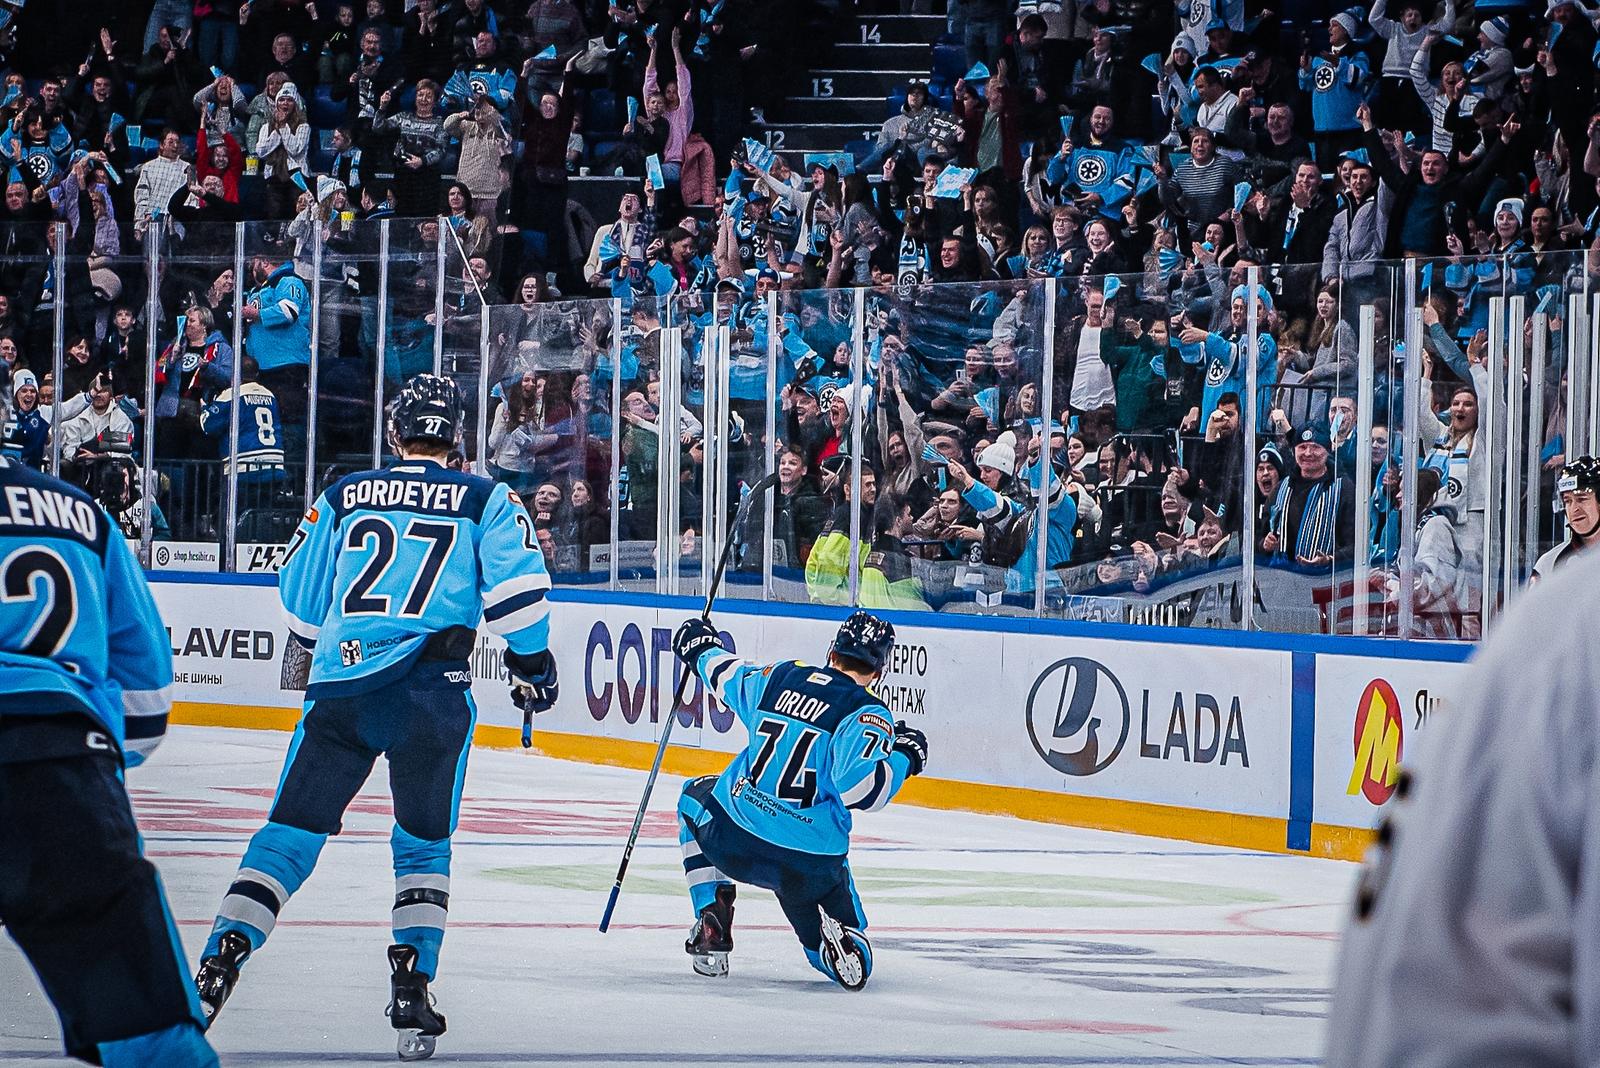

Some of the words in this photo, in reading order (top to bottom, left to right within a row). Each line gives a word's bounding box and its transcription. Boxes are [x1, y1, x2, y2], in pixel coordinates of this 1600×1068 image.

[860, 24, 881, 44] 14
[812, 78, 834, 97] 13
[765, 130, 785, 149] 12
[255, 407, 276, 446] 8
[425, 418, 442, 435] 27
[343, 480, 468, 511] GORDEYEV
[0, 486, 97, 542] ENKO
[341, 515, 458, 619] 27
[862, 624, 875, 638] 74
[191, 673, 222, 685] ШИНЫ
[775, 689, 830, 723] ORLOV
[1140, 689, 1250, 768] LADA
[755, 718, 823, 809] 74
[744, 794, 777, 817] ОБЛАСТЬ
[747, 787, 813, 825] НОВОСИБИРСКАЯ
